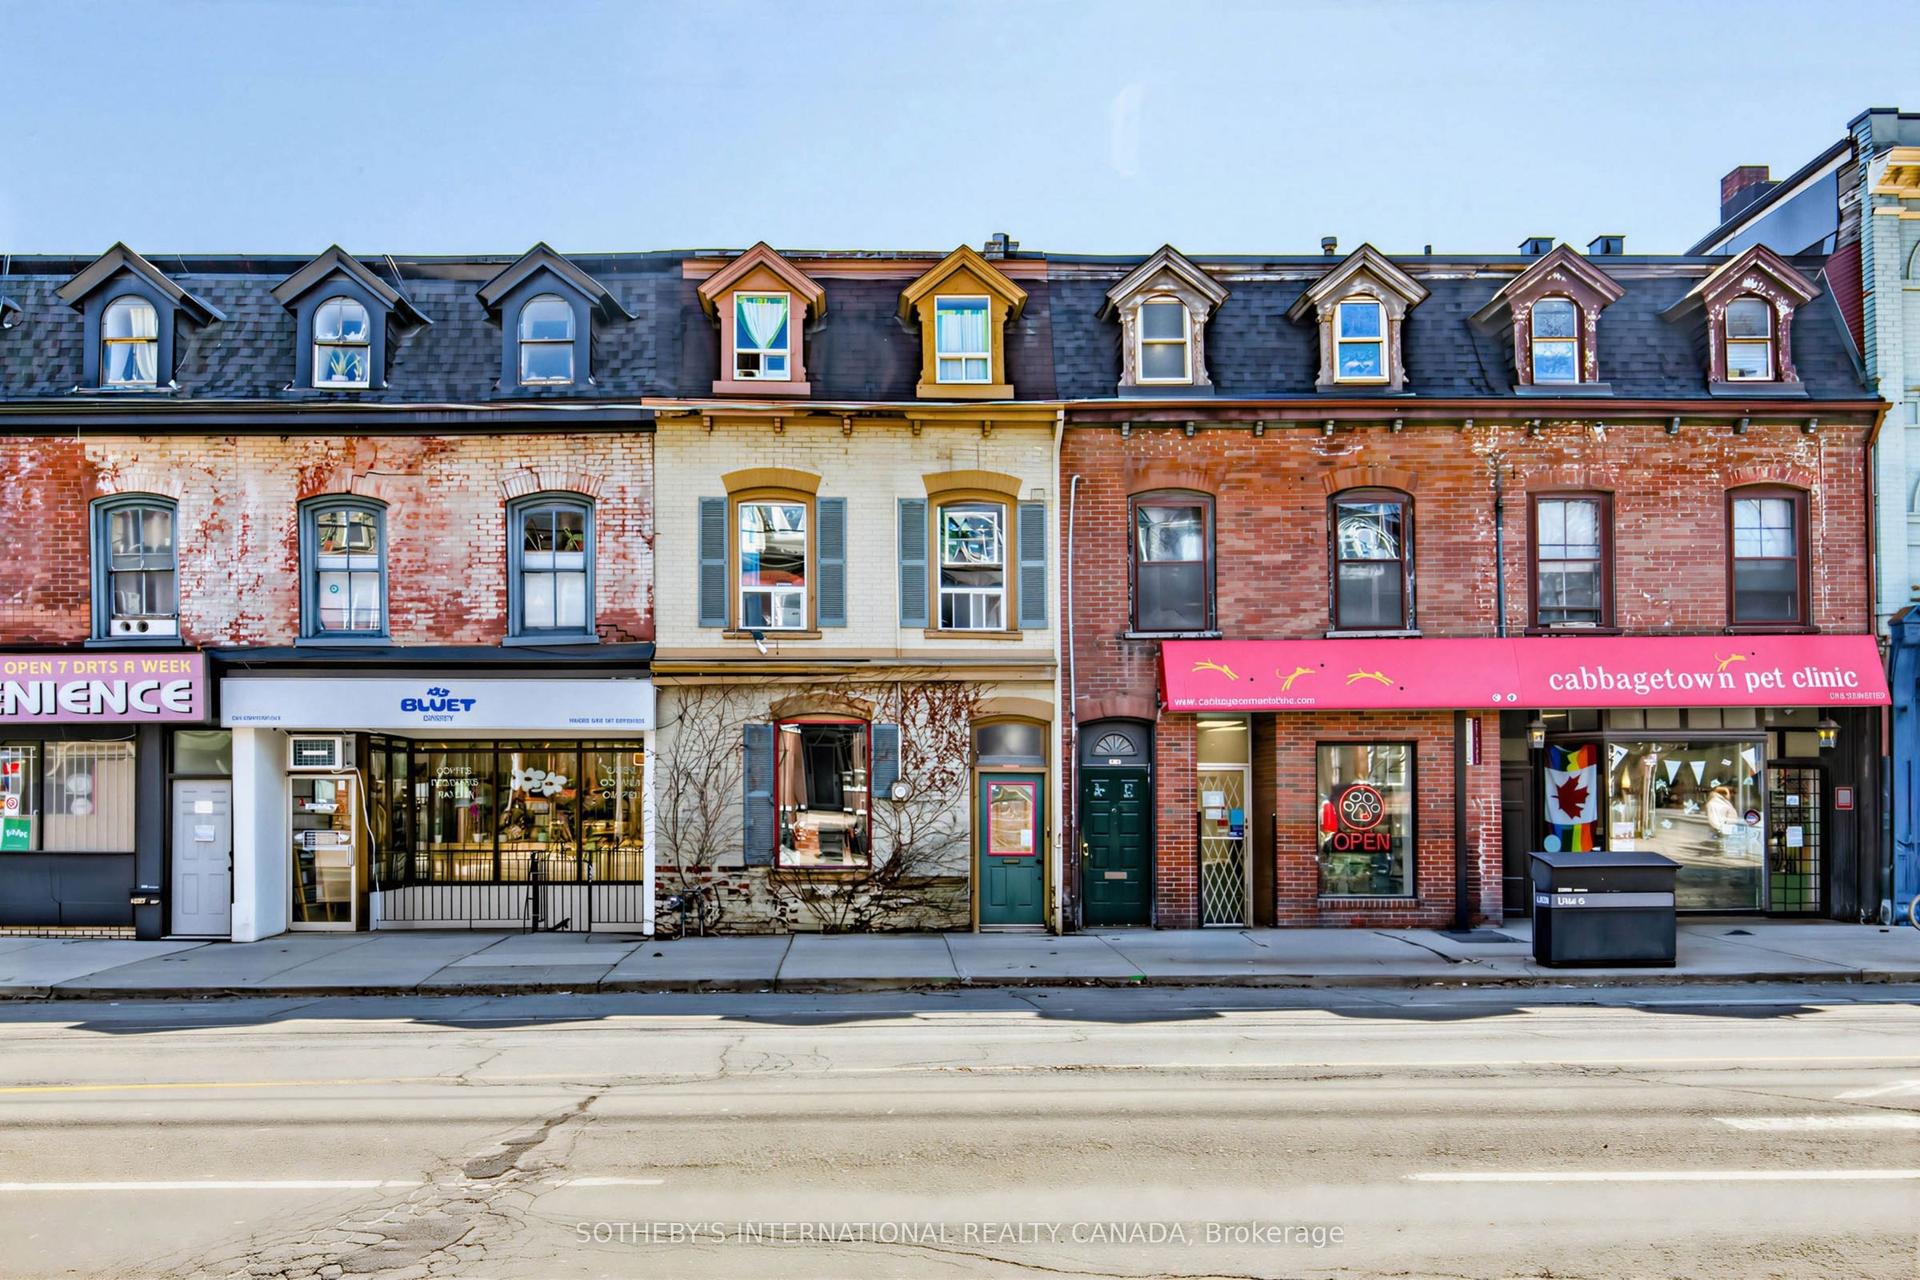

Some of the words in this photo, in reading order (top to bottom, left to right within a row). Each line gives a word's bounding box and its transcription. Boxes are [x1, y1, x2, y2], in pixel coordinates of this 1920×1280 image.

[4, 661, 52, 674] OPEN
[57, 661, 67, 674] 7
[141, 660, 192, 673] WEEK
[1549, 666, 1736, 694] cabbagetown
[1745, 667, 1785, 693] pet
[1792, 666, 1859, 688] clinic
[0, 679, 192, 715] NIENCE
[401, 699, 476, 712] BLUET
[1334, 833, 1390, 850] OPEN
